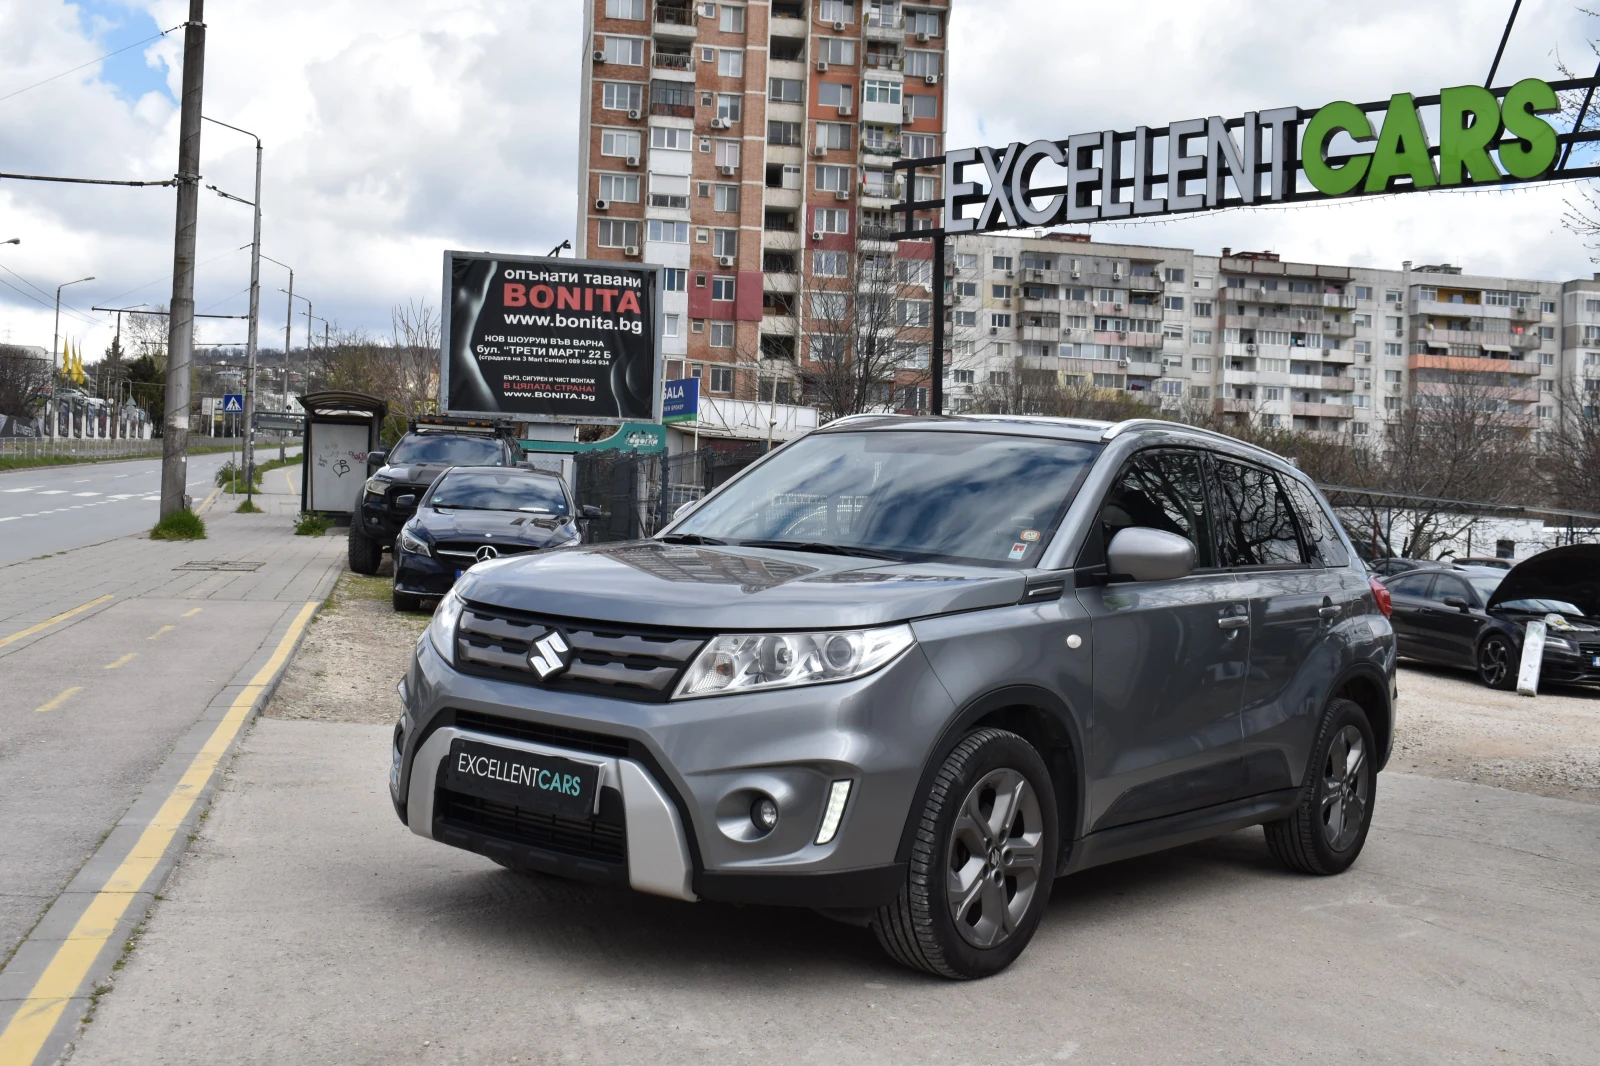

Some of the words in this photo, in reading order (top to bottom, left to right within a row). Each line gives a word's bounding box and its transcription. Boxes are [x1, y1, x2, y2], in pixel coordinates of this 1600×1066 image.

[504, 269, 579, 283] опънати
[584, 273, 642, 288] тавани
[503, 283, 641, 314] BONITA
[503, 313, 642, 335] www.bonita.bg
[507, 336, 548, 345] ШОУРУМ
[573, 339, 604, 347] ВАРНА
[476, 345, 500, 354] бул.
[504, 346, 546, 355] “ТРЕТИ
[548, 348, 585, 357] МАРТ”
[588, 350, 601, 358] 22
[544, 357, 567, 365] Center)
[513, 383, 552, 391] ЦЯЛАТА
[554, 384, 596, 392] СТРАНА!
[504, 391, 595, 401] www.BONITA.bg
